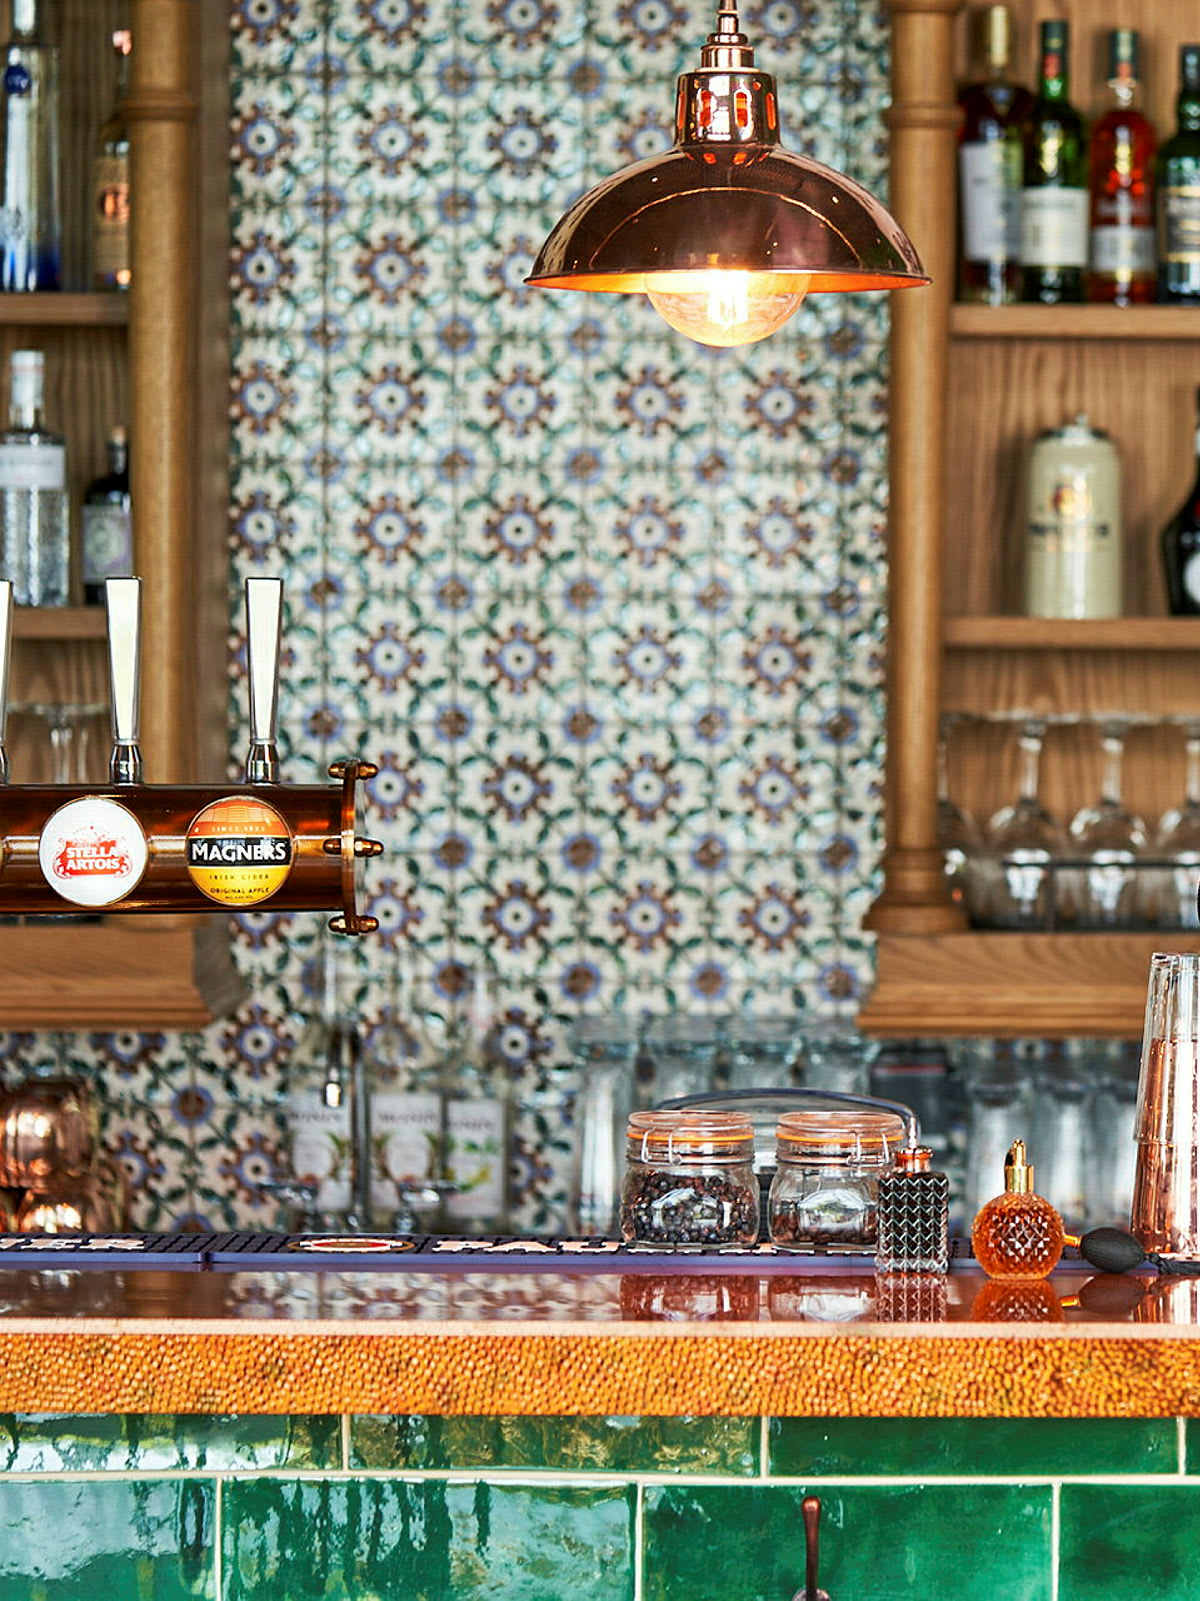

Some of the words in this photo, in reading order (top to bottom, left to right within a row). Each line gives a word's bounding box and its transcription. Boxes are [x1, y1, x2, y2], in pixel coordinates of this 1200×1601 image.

[66, 847, 120, 859] STELLA
[192, 842, 287, 862] MAGNERS
[66, 858, 121, 870] ARTOIS
